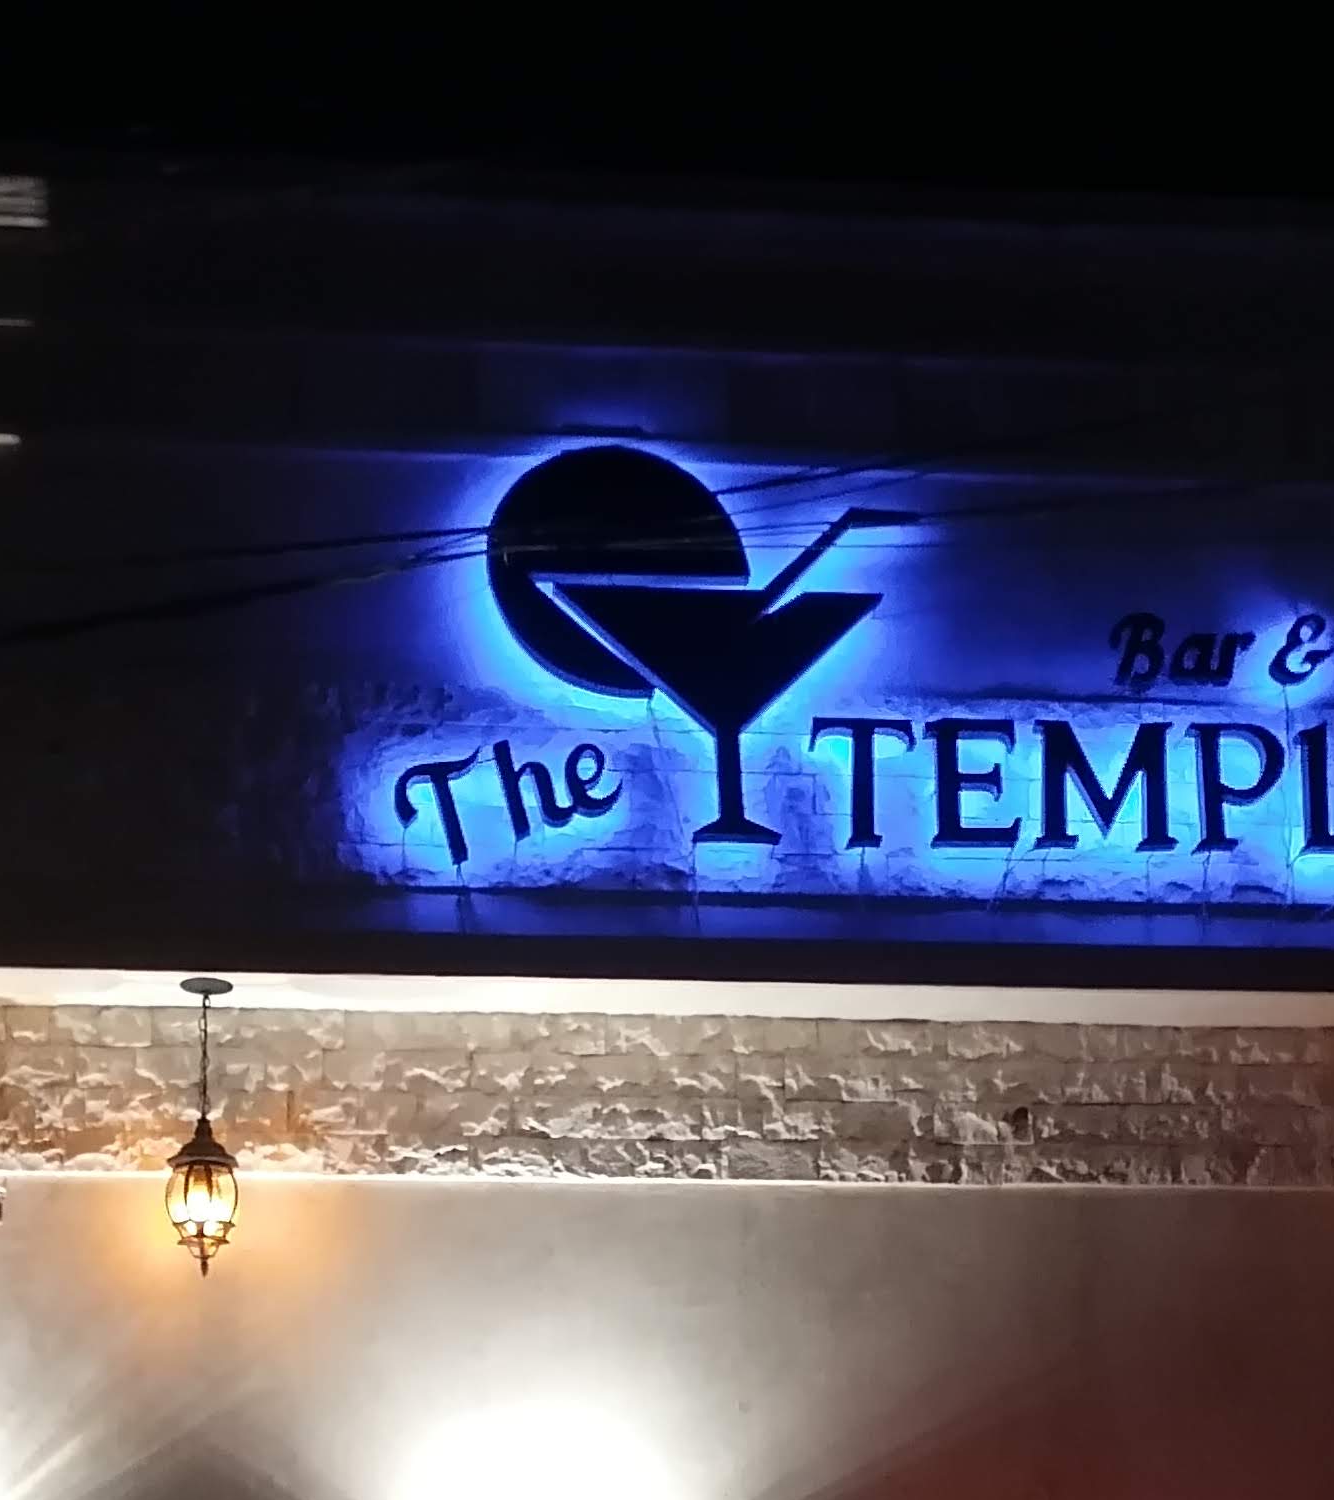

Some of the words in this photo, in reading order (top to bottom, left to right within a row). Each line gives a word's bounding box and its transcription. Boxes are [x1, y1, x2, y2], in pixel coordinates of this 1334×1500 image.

[1110, 613, 1256, 687] Bar
[1269, 613, 1334, 686] &
[395, 739, 623, 865] The
